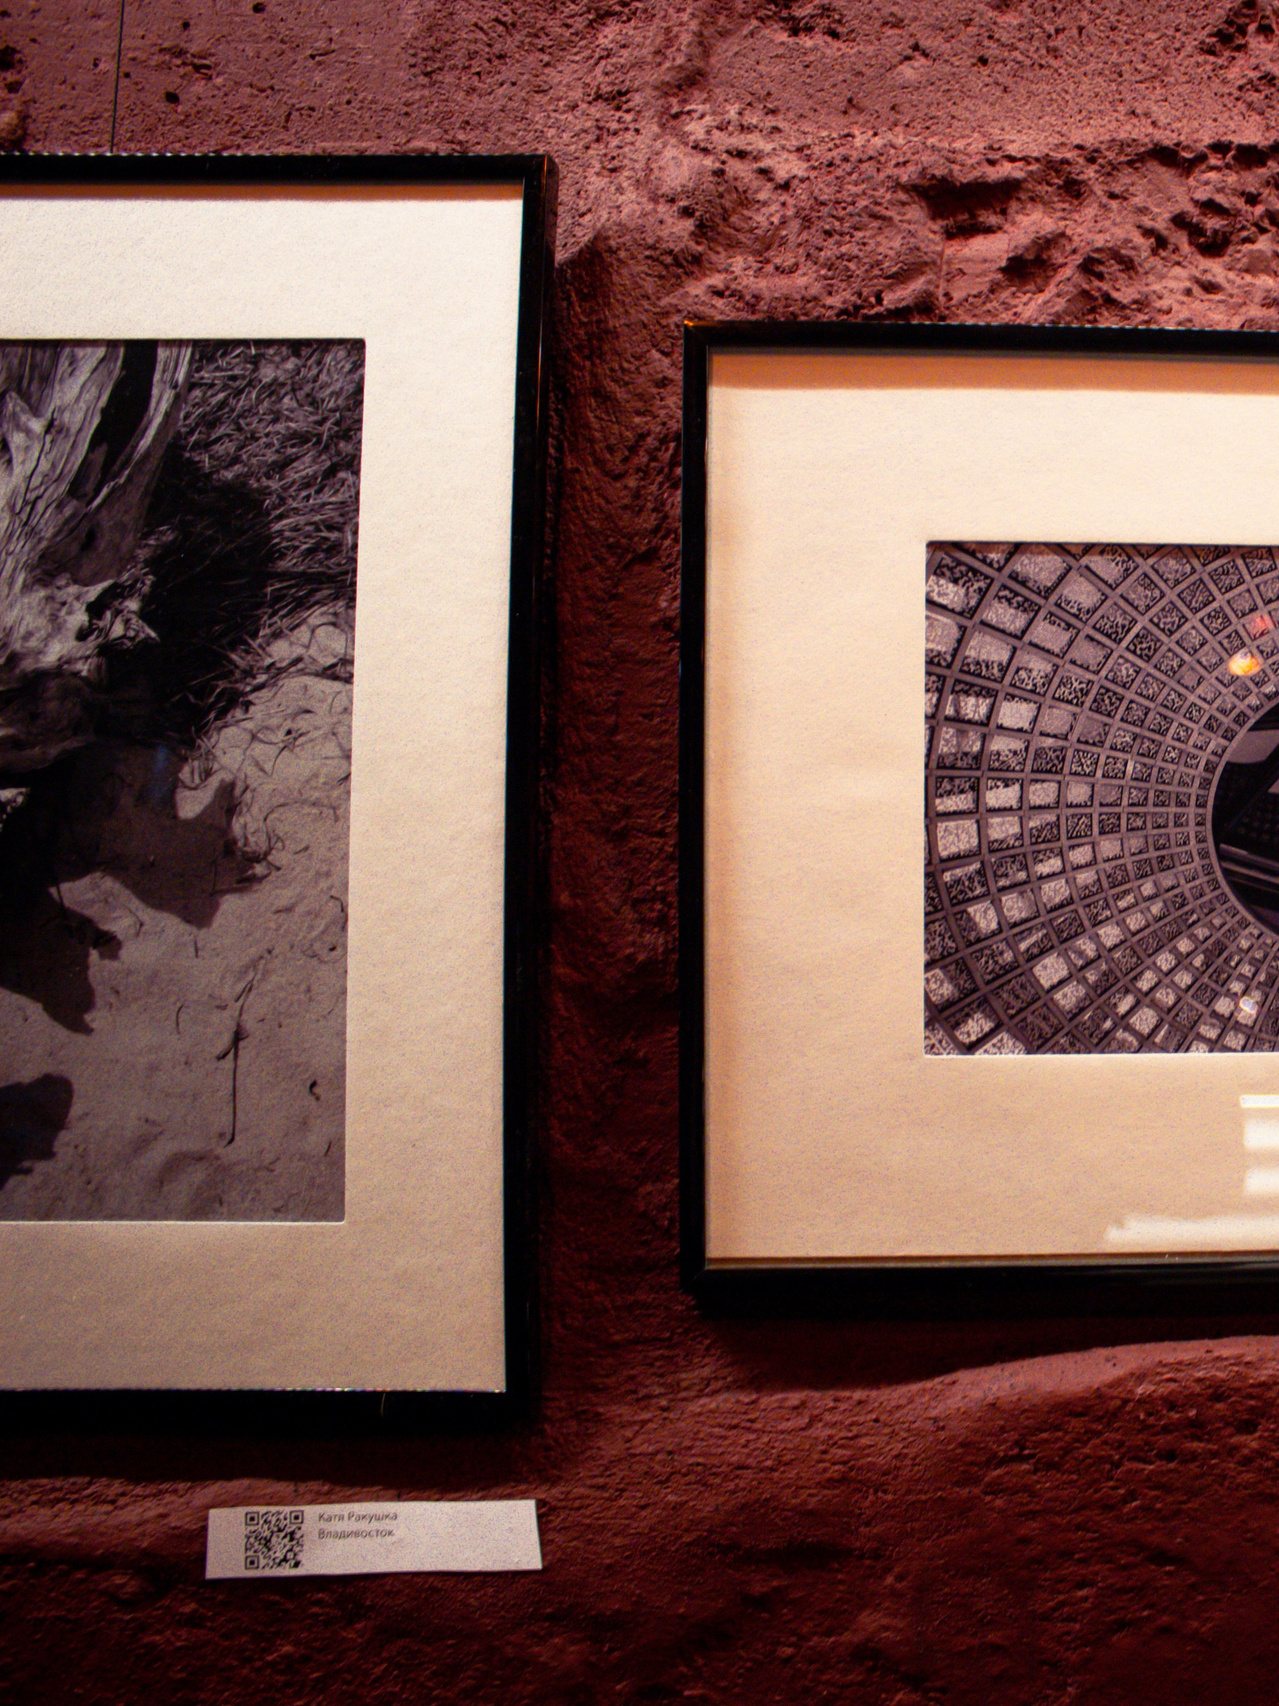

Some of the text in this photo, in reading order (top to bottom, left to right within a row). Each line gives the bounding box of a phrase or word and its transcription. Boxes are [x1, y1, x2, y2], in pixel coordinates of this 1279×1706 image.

[318, 1511, 398, 1524] Катя Ракушка
[318, 1527, 394, 1540] Владивосток
